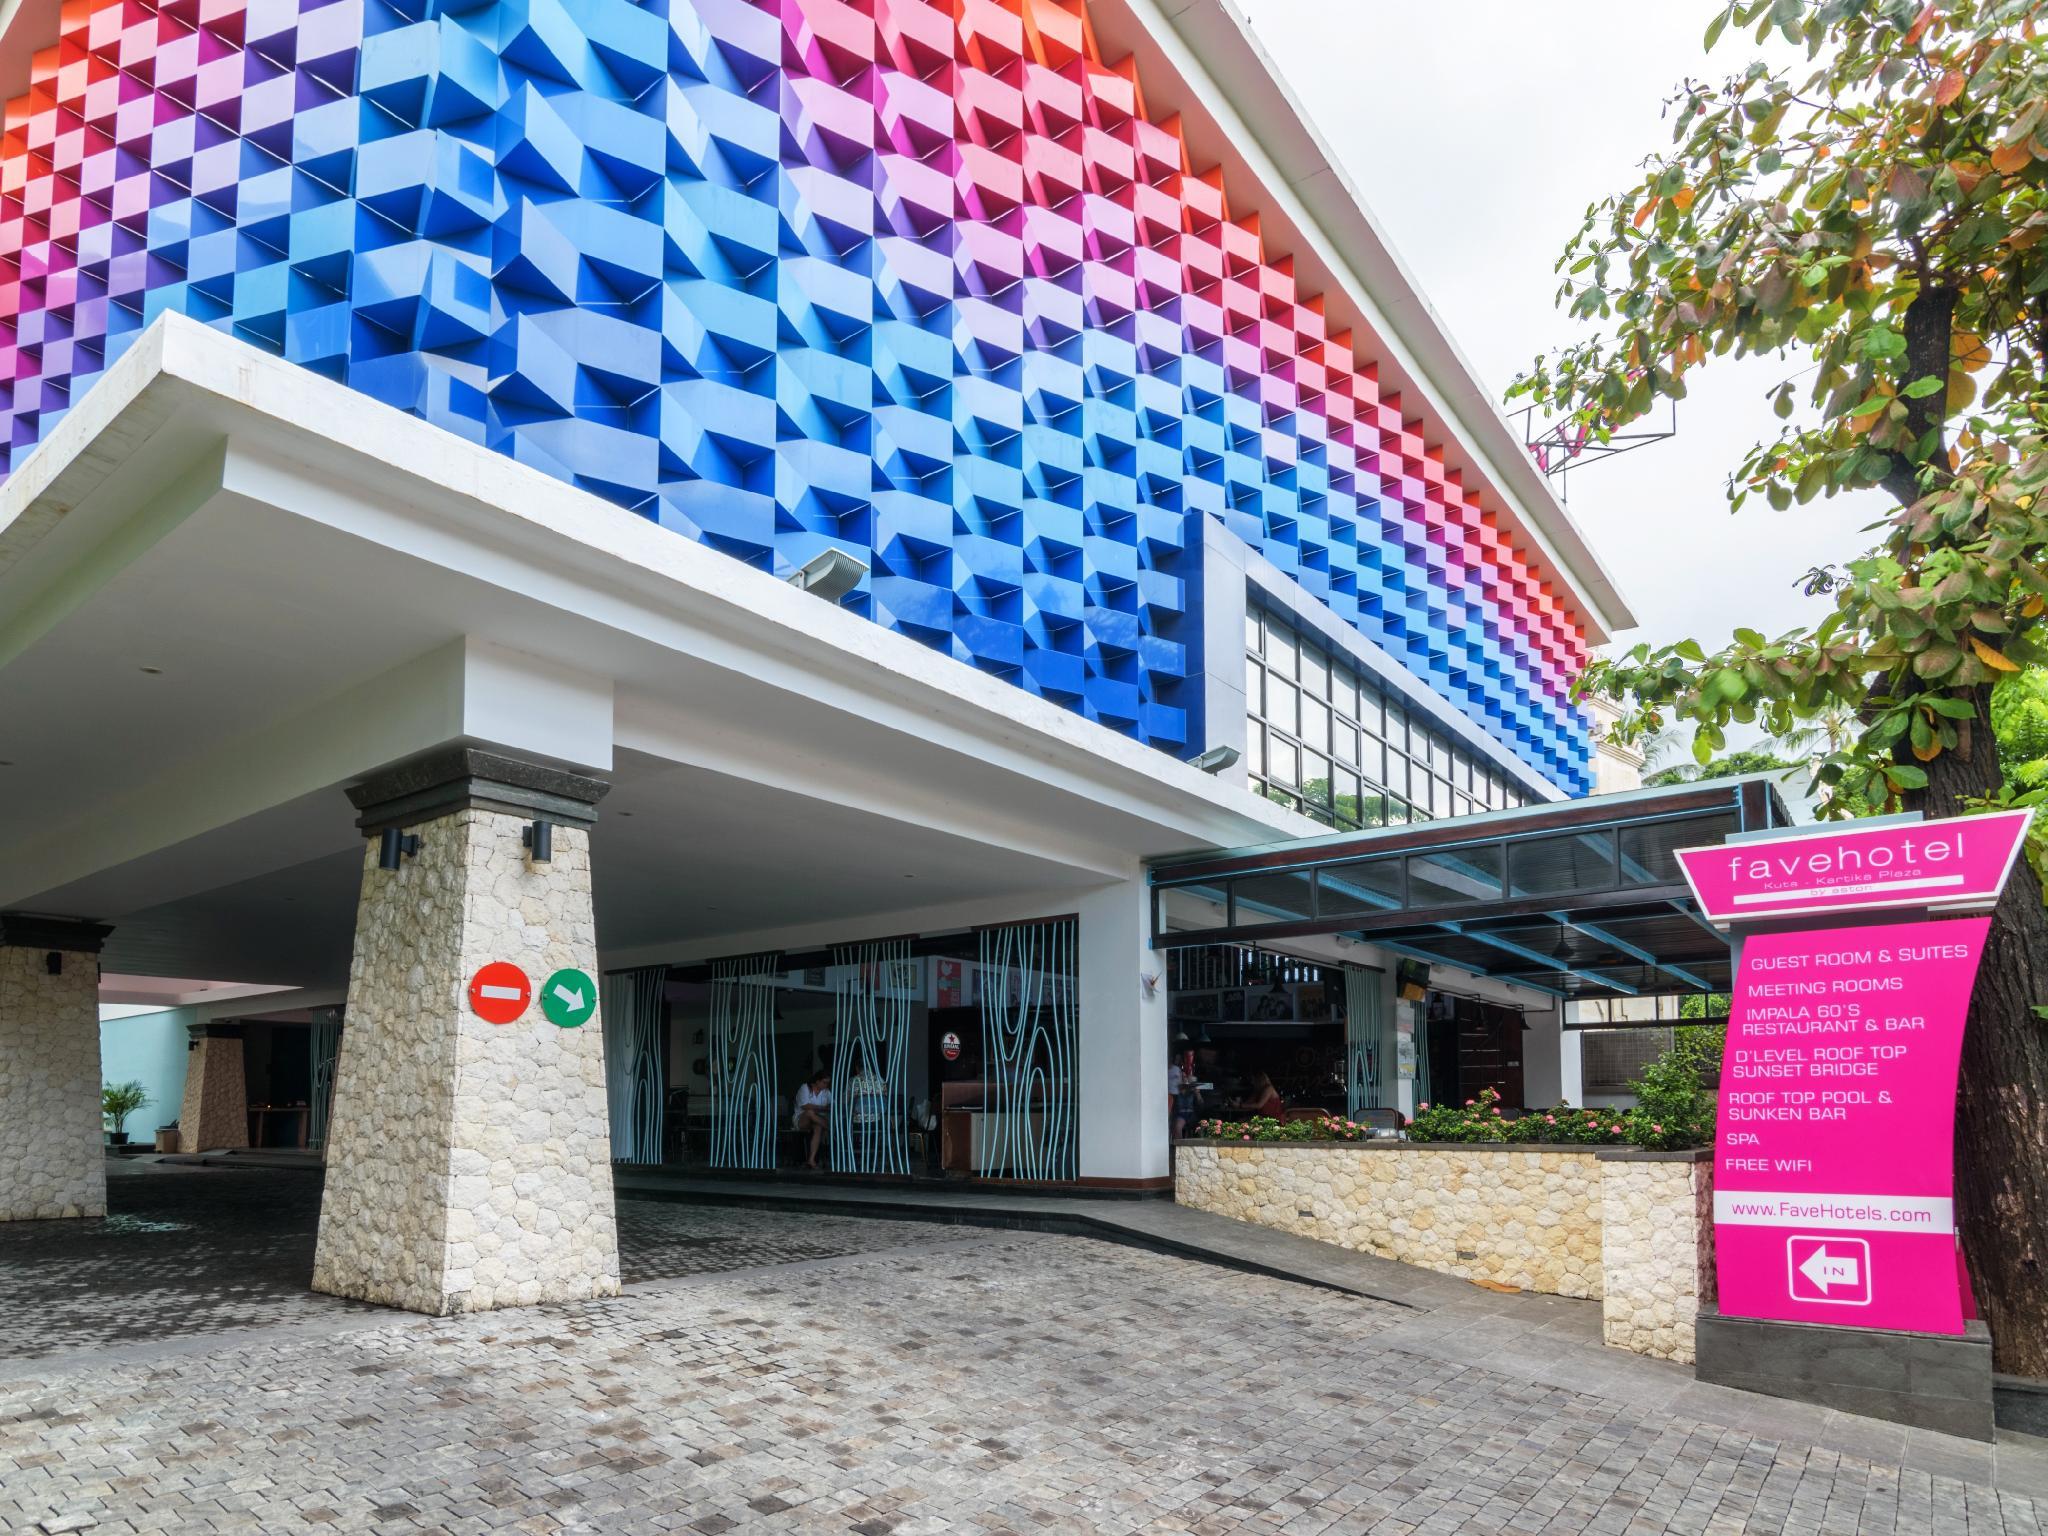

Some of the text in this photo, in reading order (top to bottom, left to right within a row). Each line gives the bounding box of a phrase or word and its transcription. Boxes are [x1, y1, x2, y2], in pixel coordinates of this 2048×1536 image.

[1728, 832, 1964, 882] favehotel
[1764, 881, 1798, 890] Kuta
[1816, 873, 1872, 885] Kartika
[1878, 868, 1922, 879] Plaza
[1810, 885, 1873, 896] by aston
[1751, 945, 1968, 971] GUEST ROOM & SUITES
[1748, 977, 1903, 997] MEETING ROOMS
[1747, 1003, 1861, 1021] IMPALA 60'S
[1743, 1016, 1925, 1036] RESTAURANT & BAR
[1735, 1045, 1907, 1063] D'LEVEL ROOF TOP
[1733, 1062, 1878, 1078] SUNSET BRIDGE
[1729, 1091, 1892, 1105] ROOF TOP POOL &
[1728, 1107, 1846, 1120] SUNKEN BAR
[1726, 1133, 1760, 1145] SPA
[1725, 1159, 1812, 1172] FREE WIFI
[1731, 1202, 1931, 1223] www.FaveHotels.com
[1823, 1266, 1845, 1276] IN
